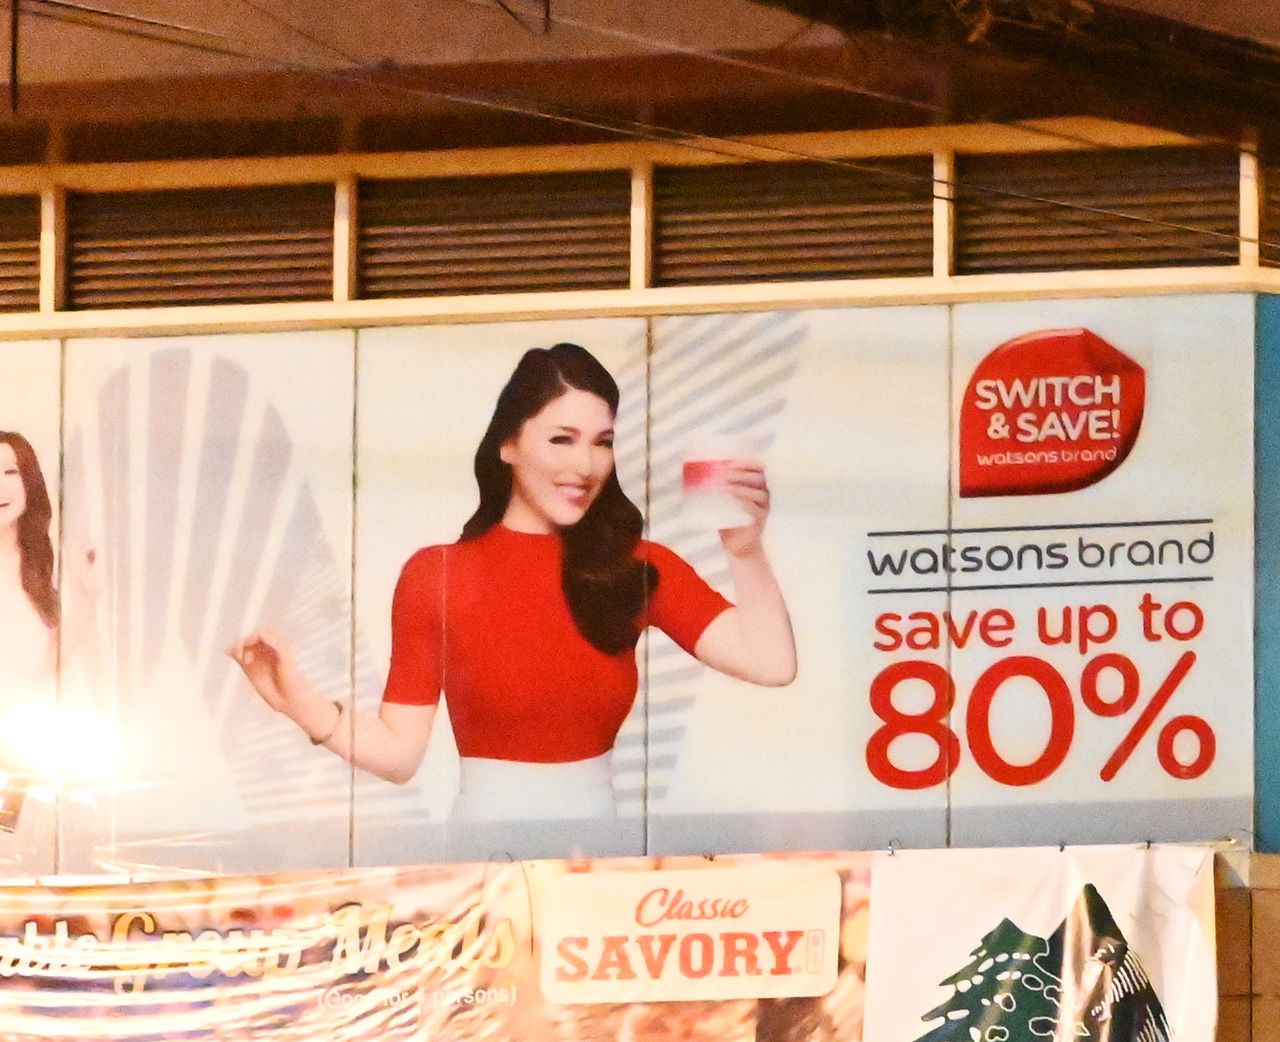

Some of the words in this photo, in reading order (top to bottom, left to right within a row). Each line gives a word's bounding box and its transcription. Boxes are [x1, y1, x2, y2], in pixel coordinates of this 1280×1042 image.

[974, 375, 1122, 410] SWITCH
[986, 413, 1011, 440] &
[1016, 409, 1122, 442] SAVE!
[976, 449, 1059, 466] watsons
[1061, 446, 1118, 464] brand
[867, 541, 1069, 577] watsons
[1078, 531, 1215, 567] brand
[873, 606, 1016, 653] save
[1037, 603, 1119, 655] up
[1138, 592, 1205, 641] to
[865, 650, 1217, 791] 80%
[635, 887, 750, 924] Classic
[555, 930, 805, 982] SAVORY
